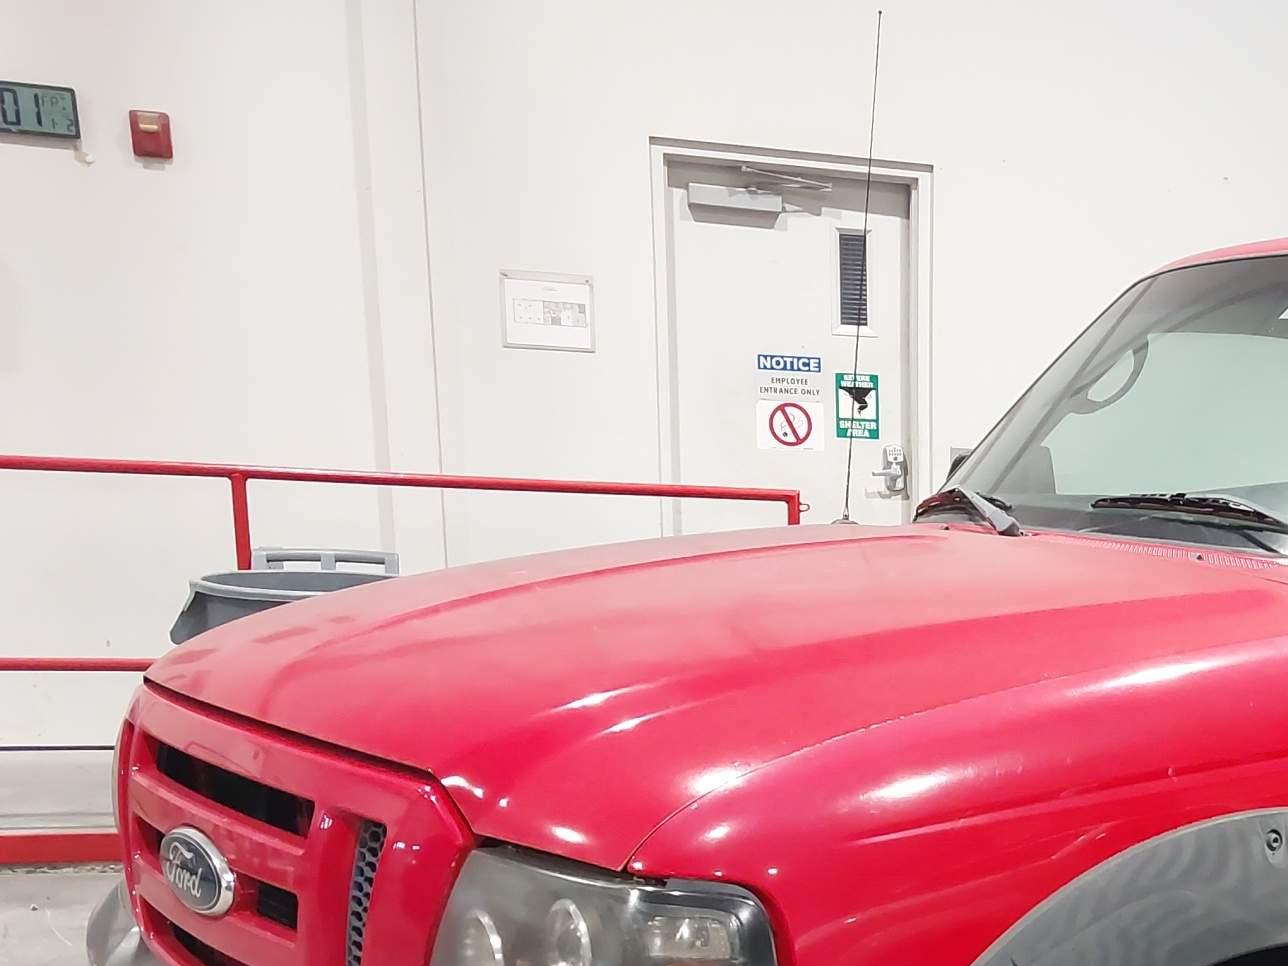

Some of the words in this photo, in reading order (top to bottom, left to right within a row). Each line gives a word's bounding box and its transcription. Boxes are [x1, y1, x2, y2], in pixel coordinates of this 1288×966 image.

[759, 356, 820, 371] NOTICE
[771, 377, 808, 385] EMPLOYEE
[760, 387, 798, 395] ENTRANCE
[801, 388, 820, 396] ONLY
[840, 420, 877, 429] SHELTER
[166, 841, 202, 898] Ford
